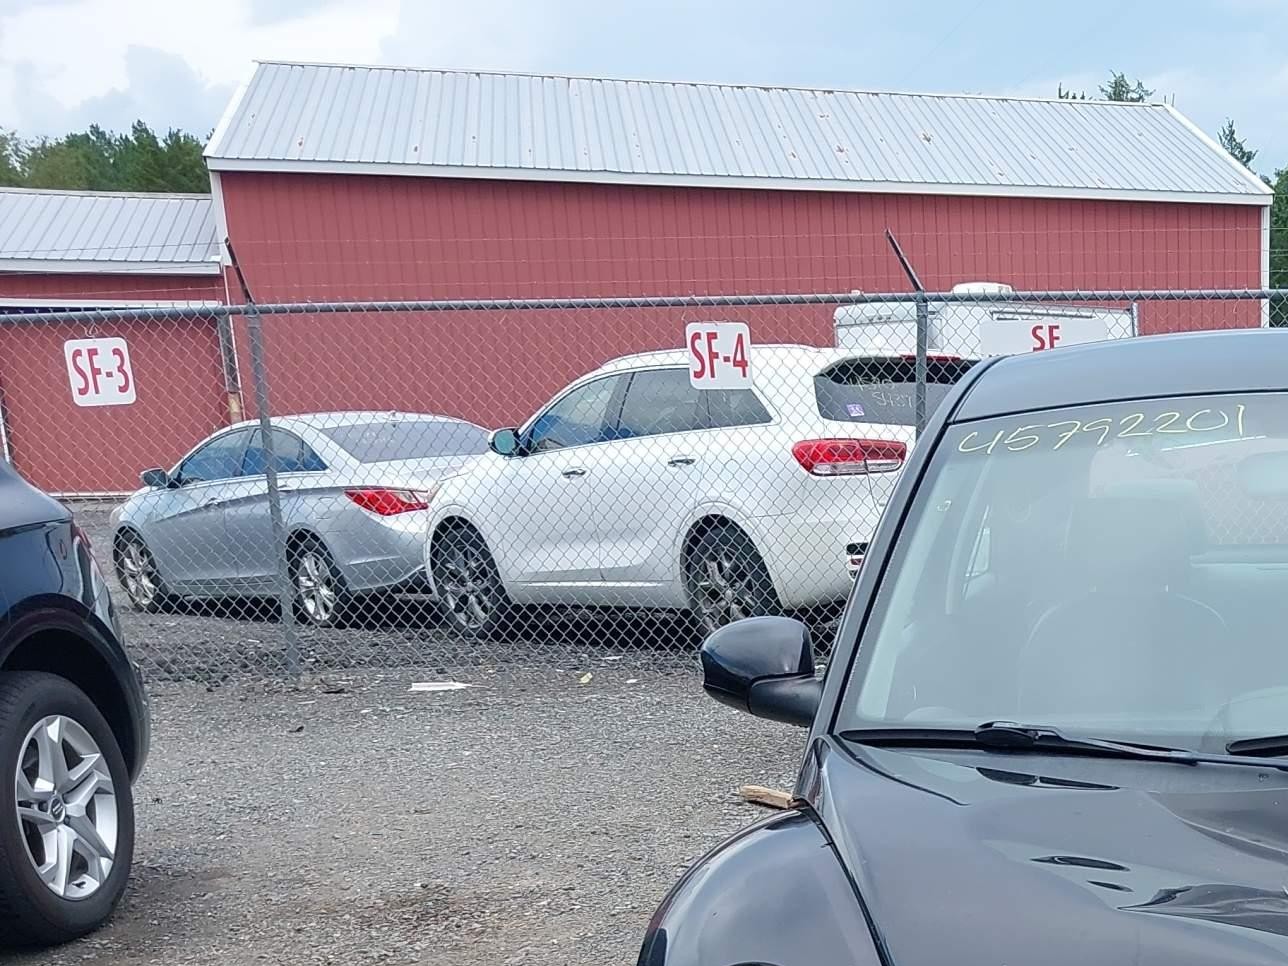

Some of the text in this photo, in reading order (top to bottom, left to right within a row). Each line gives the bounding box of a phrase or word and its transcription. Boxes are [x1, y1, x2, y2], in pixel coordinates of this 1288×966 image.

[71, 347, 130, 396] SF-3
[690, 331, 749, 379] SF-4
[958, 404, 1245, 455] 45792201
